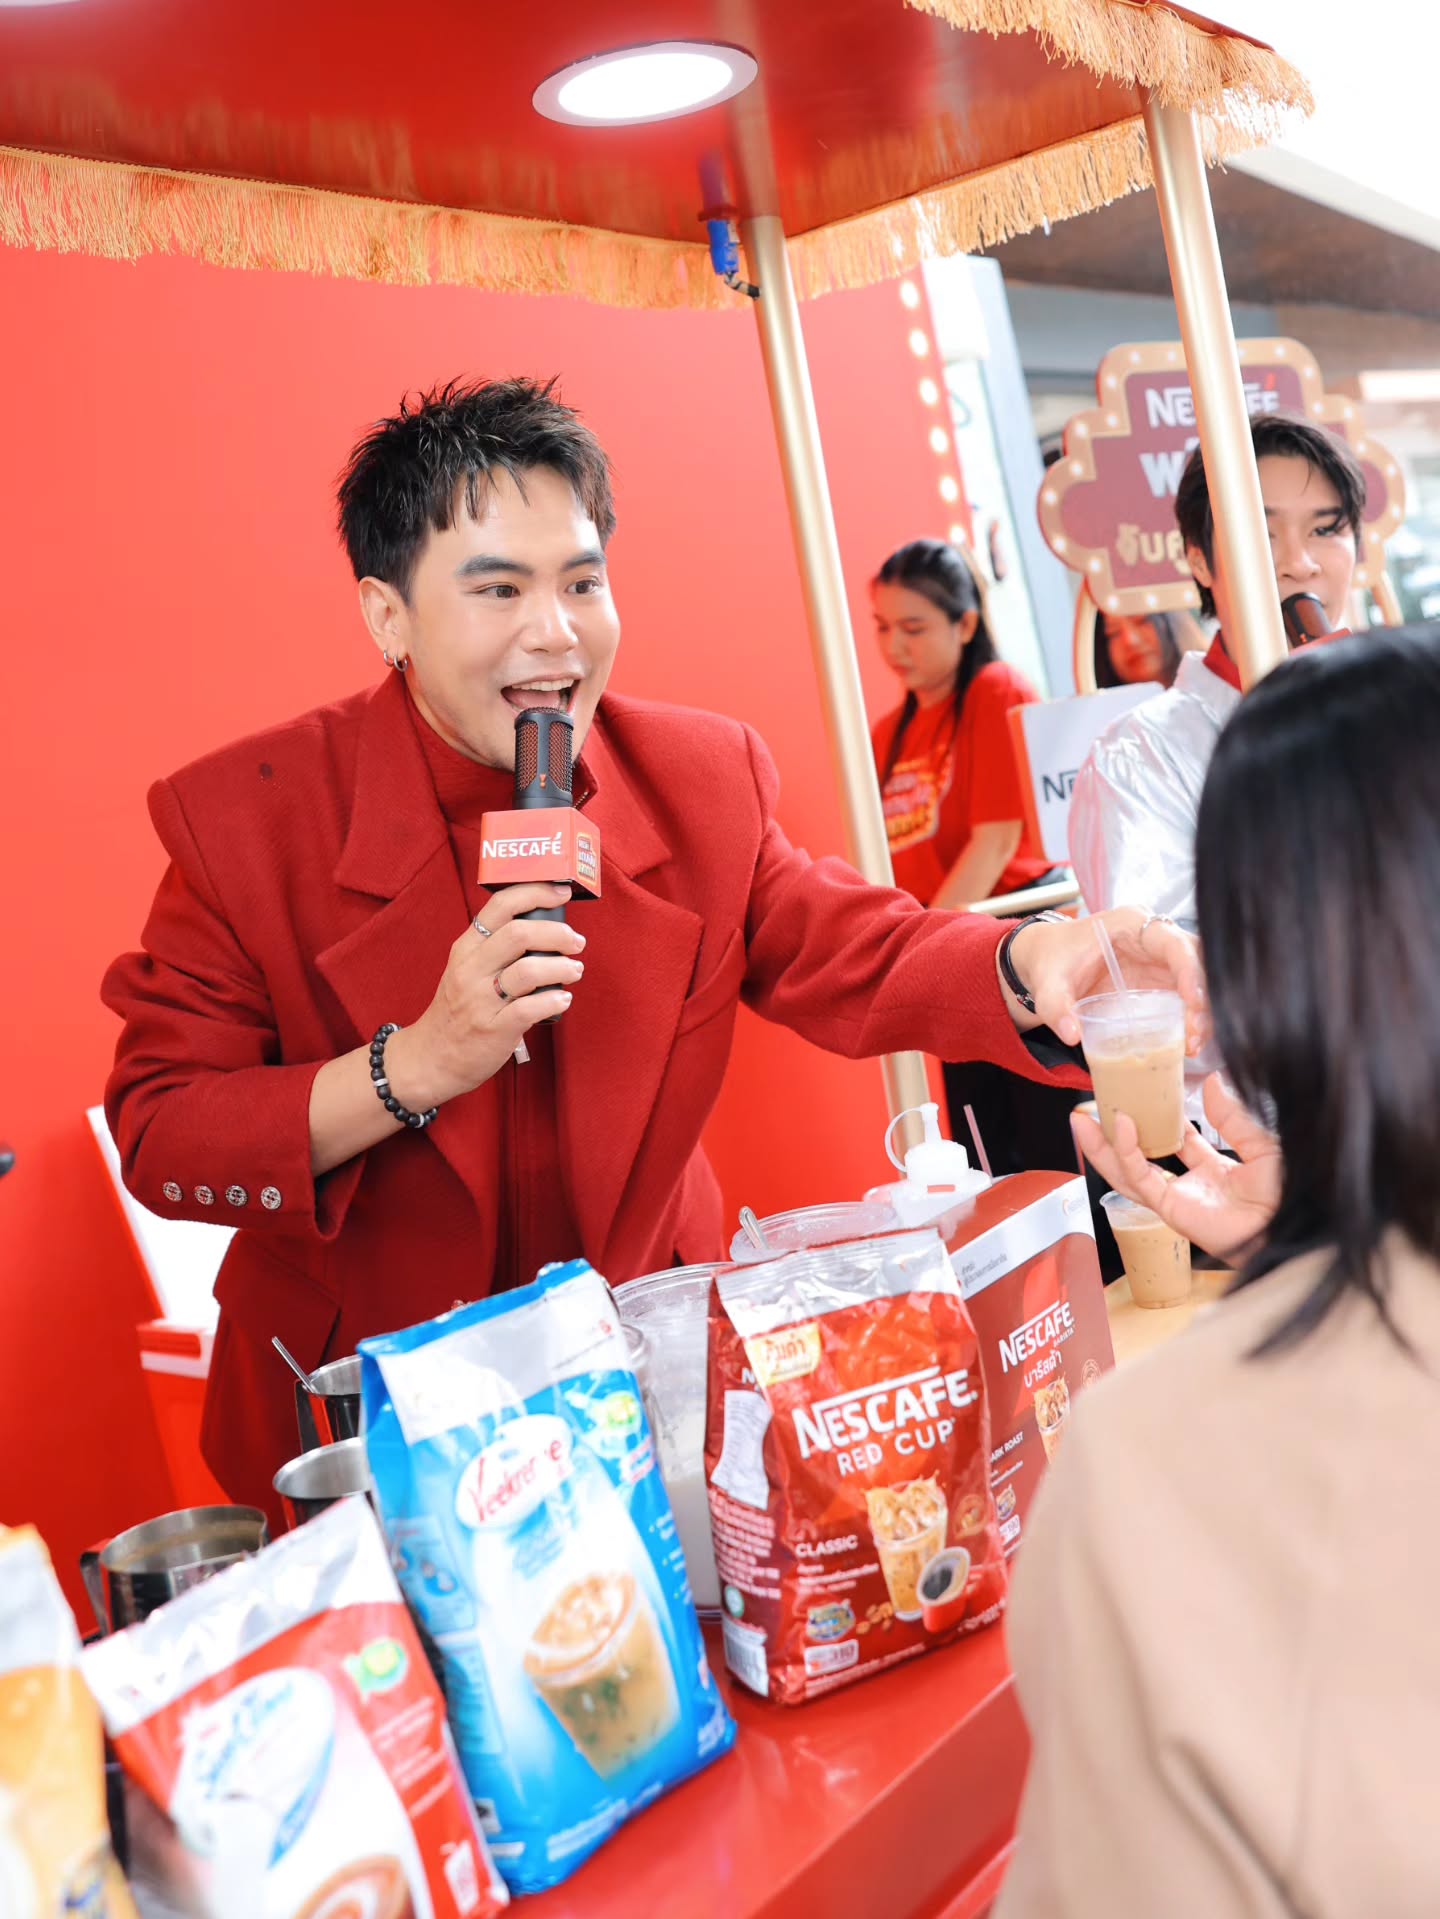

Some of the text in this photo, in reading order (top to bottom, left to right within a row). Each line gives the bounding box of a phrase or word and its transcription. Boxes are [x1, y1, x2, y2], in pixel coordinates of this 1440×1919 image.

[482, 832, 562, 859] NESCAFÉ
[836, 1419, 955, 1478] RED CUP
[1004, 1431, 1024, 1452] ROAST
[796, 1534, 858, 1558] CLASSIC
